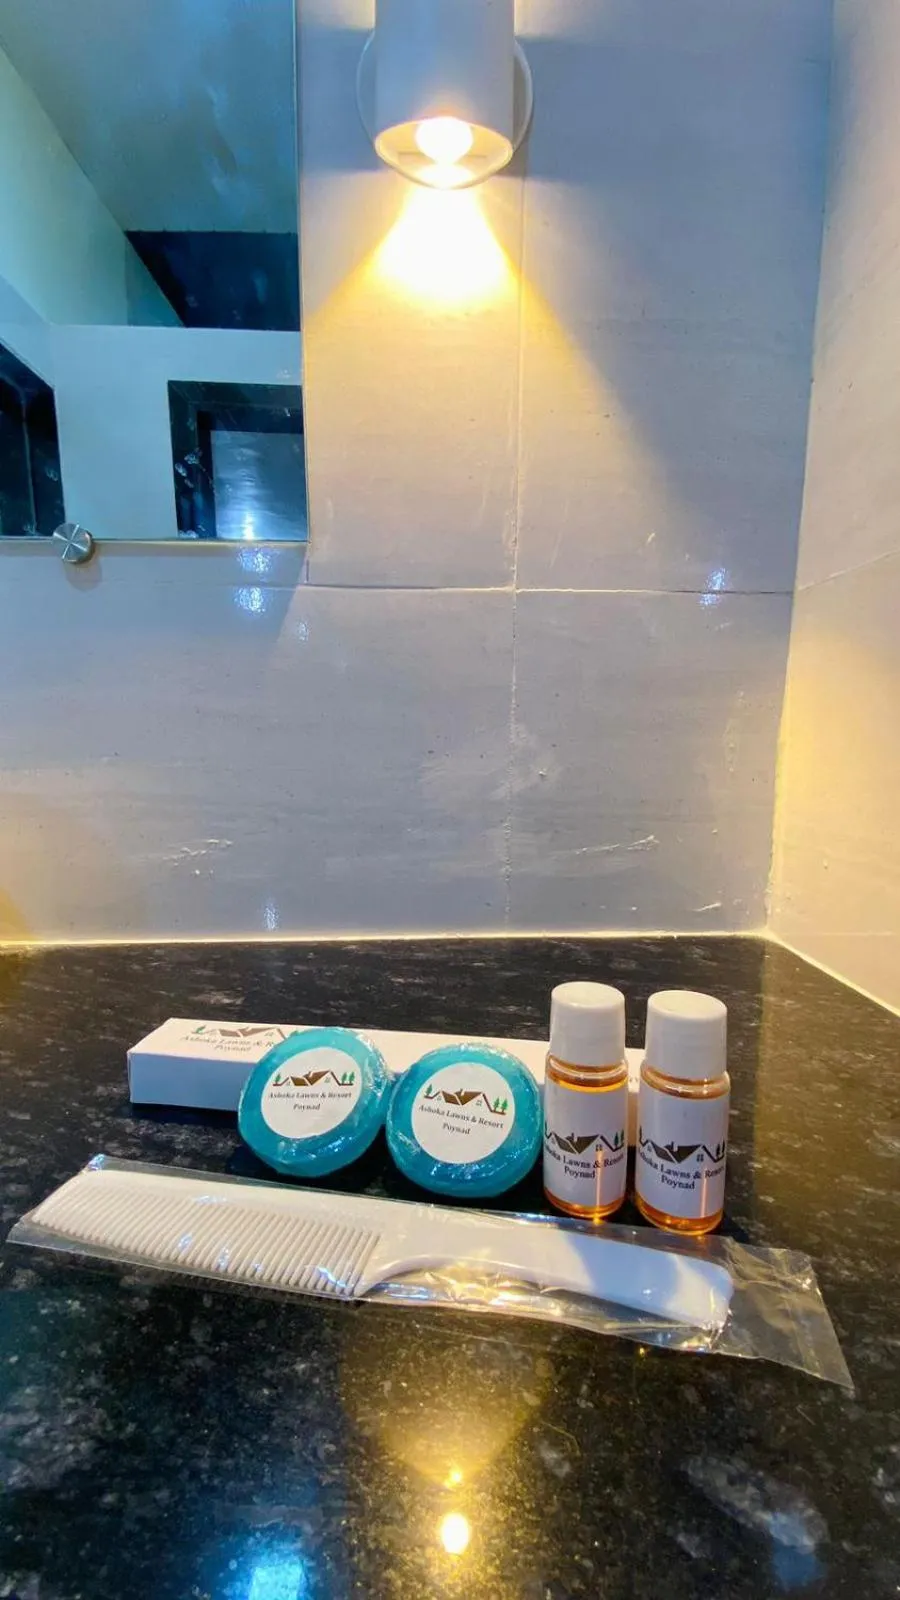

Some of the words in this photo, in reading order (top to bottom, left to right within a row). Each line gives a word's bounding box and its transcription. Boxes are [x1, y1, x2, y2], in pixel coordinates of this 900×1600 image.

[269, 1091, 294, 1099] Ashoka
[296, 1091, 318, 1099] Lawns
[293, 1103, 321, 1112] Poynad
[419, 1104, 446, 1116] Ashoka
[446, 1110, 470, 1122] Lawns
[470, 1115, 478, 1123] &
[478, 1117, 504, 1129] Resort
[442, 1121, 471, 1136] Poynad
[563, 1155, 591, 1169] Lawns
[564, 1165, 596, 1179] Poynad
[660, 1163, 691, 1179] Lawns
[692, 1170, 702, 1179] &
[661, 1174, 696, 1190] Poynad
